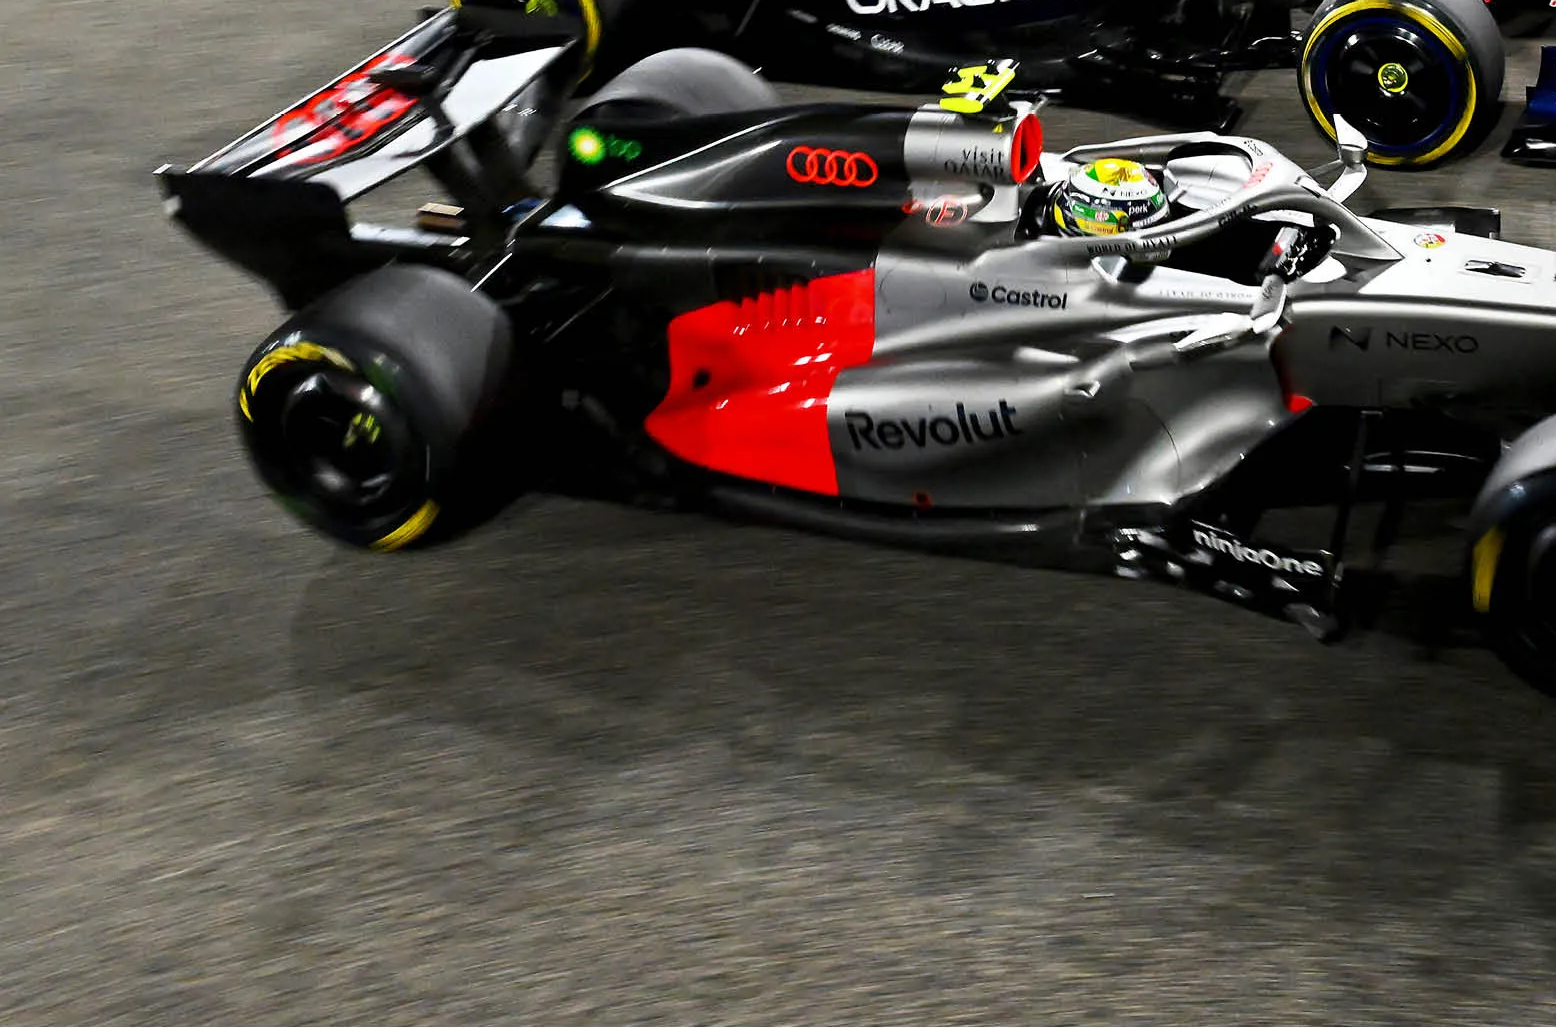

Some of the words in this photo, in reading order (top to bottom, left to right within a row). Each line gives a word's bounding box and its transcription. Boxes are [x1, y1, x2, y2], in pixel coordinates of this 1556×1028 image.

[991, 285, 1068, 309] Castrol
[1386, 330, 1479, 354] NEXO
[844, 398, 1022, 452] Revolut
[1192, 528, 1324, 577] ninjaOne
